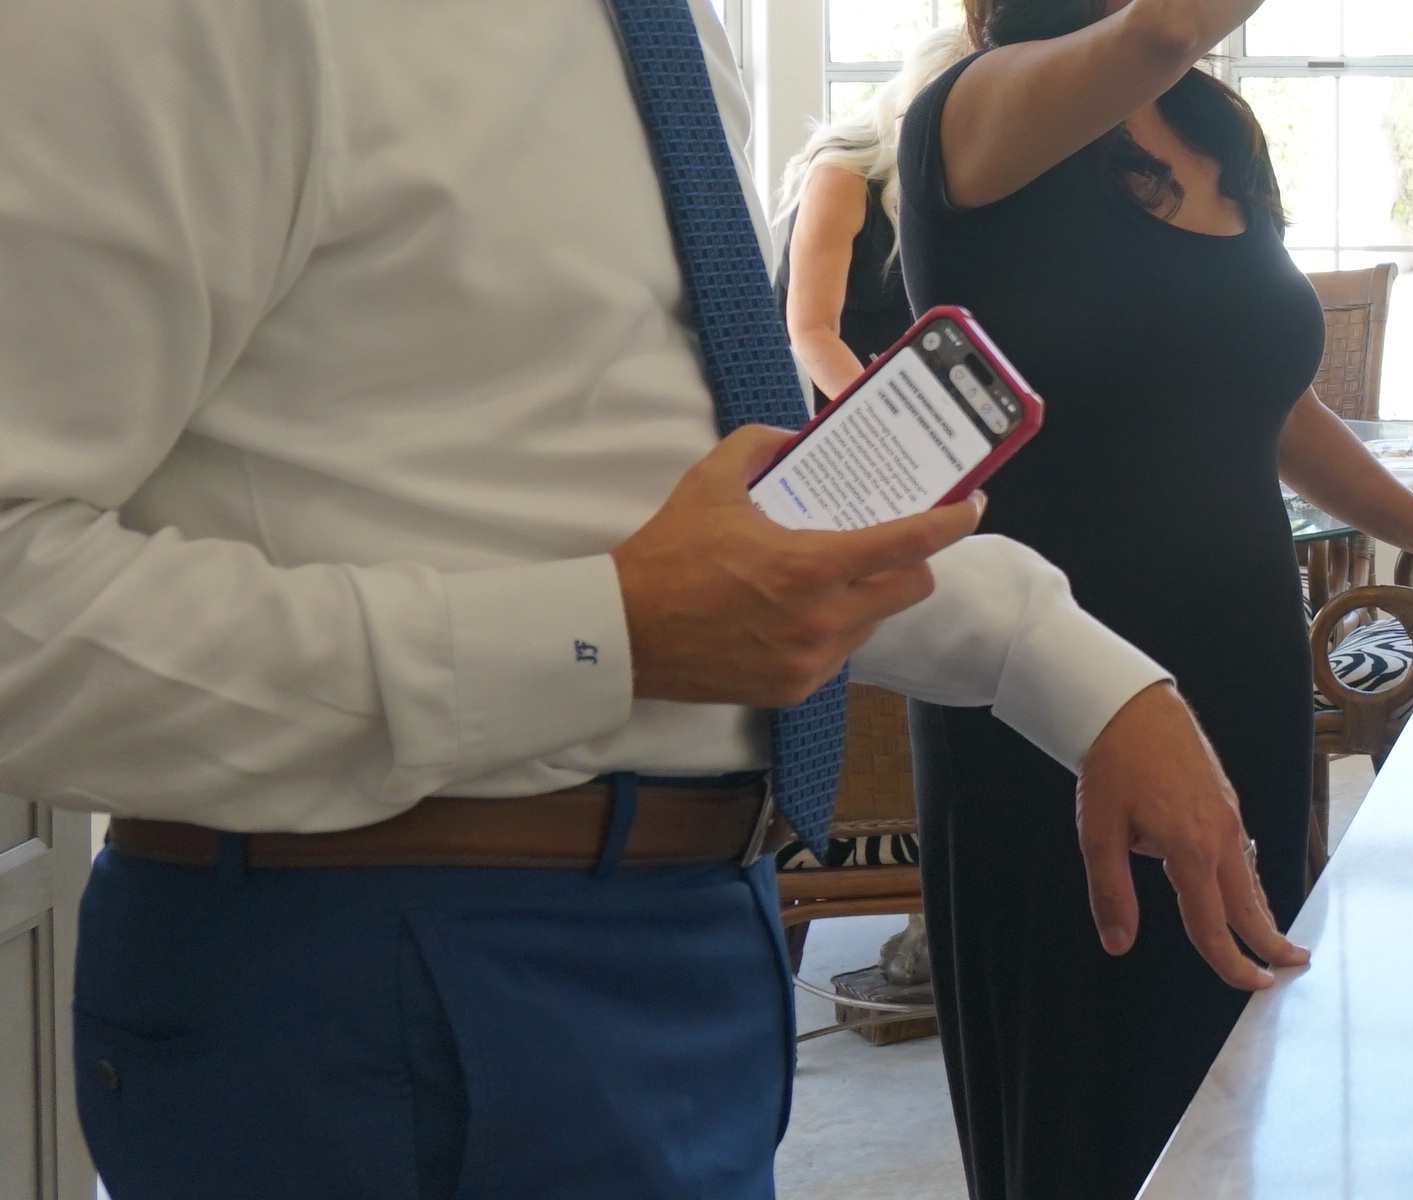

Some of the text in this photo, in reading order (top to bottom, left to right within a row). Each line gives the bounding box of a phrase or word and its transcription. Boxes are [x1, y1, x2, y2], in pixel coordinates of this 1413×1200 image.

[844, 414, 875, 449] Reimagined
[871, 446, 886, 463] from
[883, 460, 894, 472] the
[889, 470, 911, 494] ground
[888, 434, 919, 470] Reimagined
[777, 476, 809, 513] Show more
